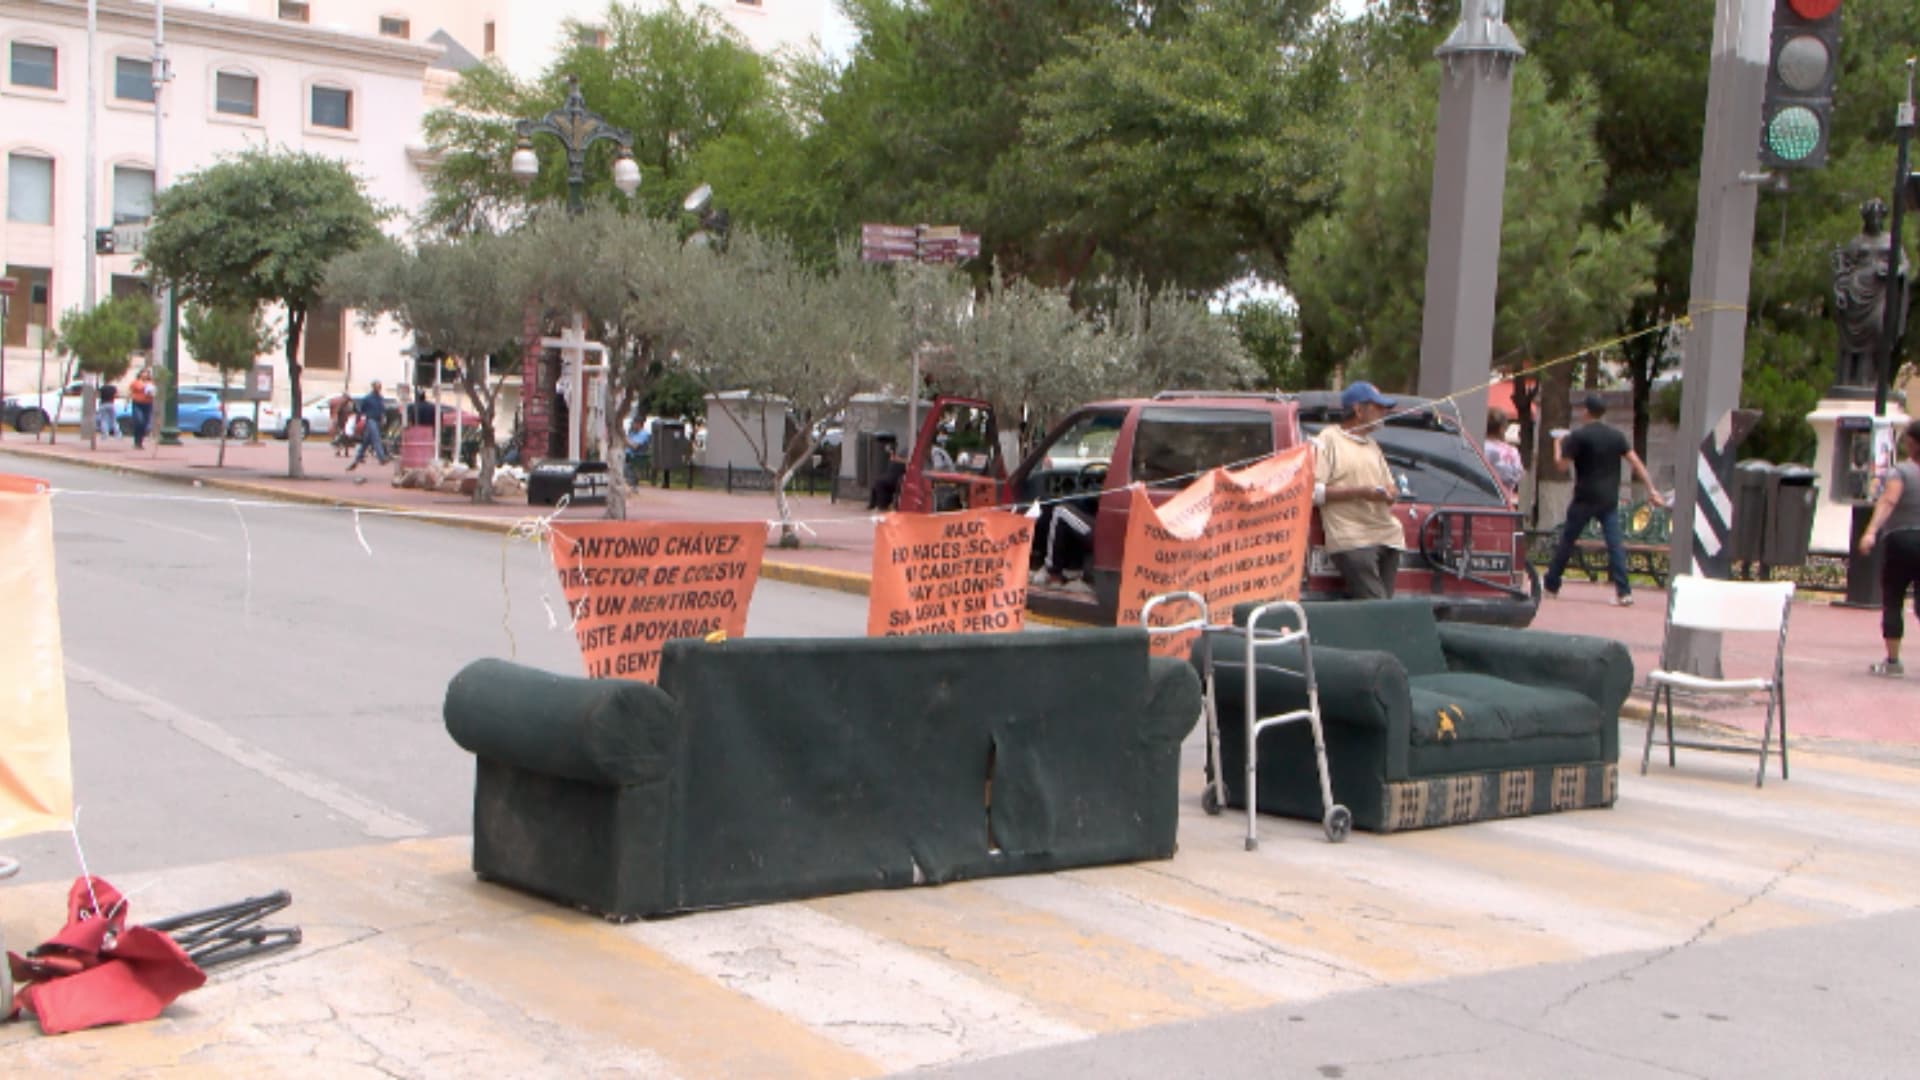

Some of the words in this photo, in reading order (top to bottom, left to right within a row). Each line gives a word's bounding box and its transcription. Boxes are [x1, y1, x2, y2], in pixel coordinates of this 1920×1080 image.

[571, 534, 660, 559] ANTONIO
[666, 530, 741, 557] CHÁVEZ
[558, 566, 650, 590] DRECTOR
[653, 565, 681, 586] DE
[596, 594, 626, 616] UN
[962, 610, 1008, 632] PERO
[616, 650, 661, 675] GENT
